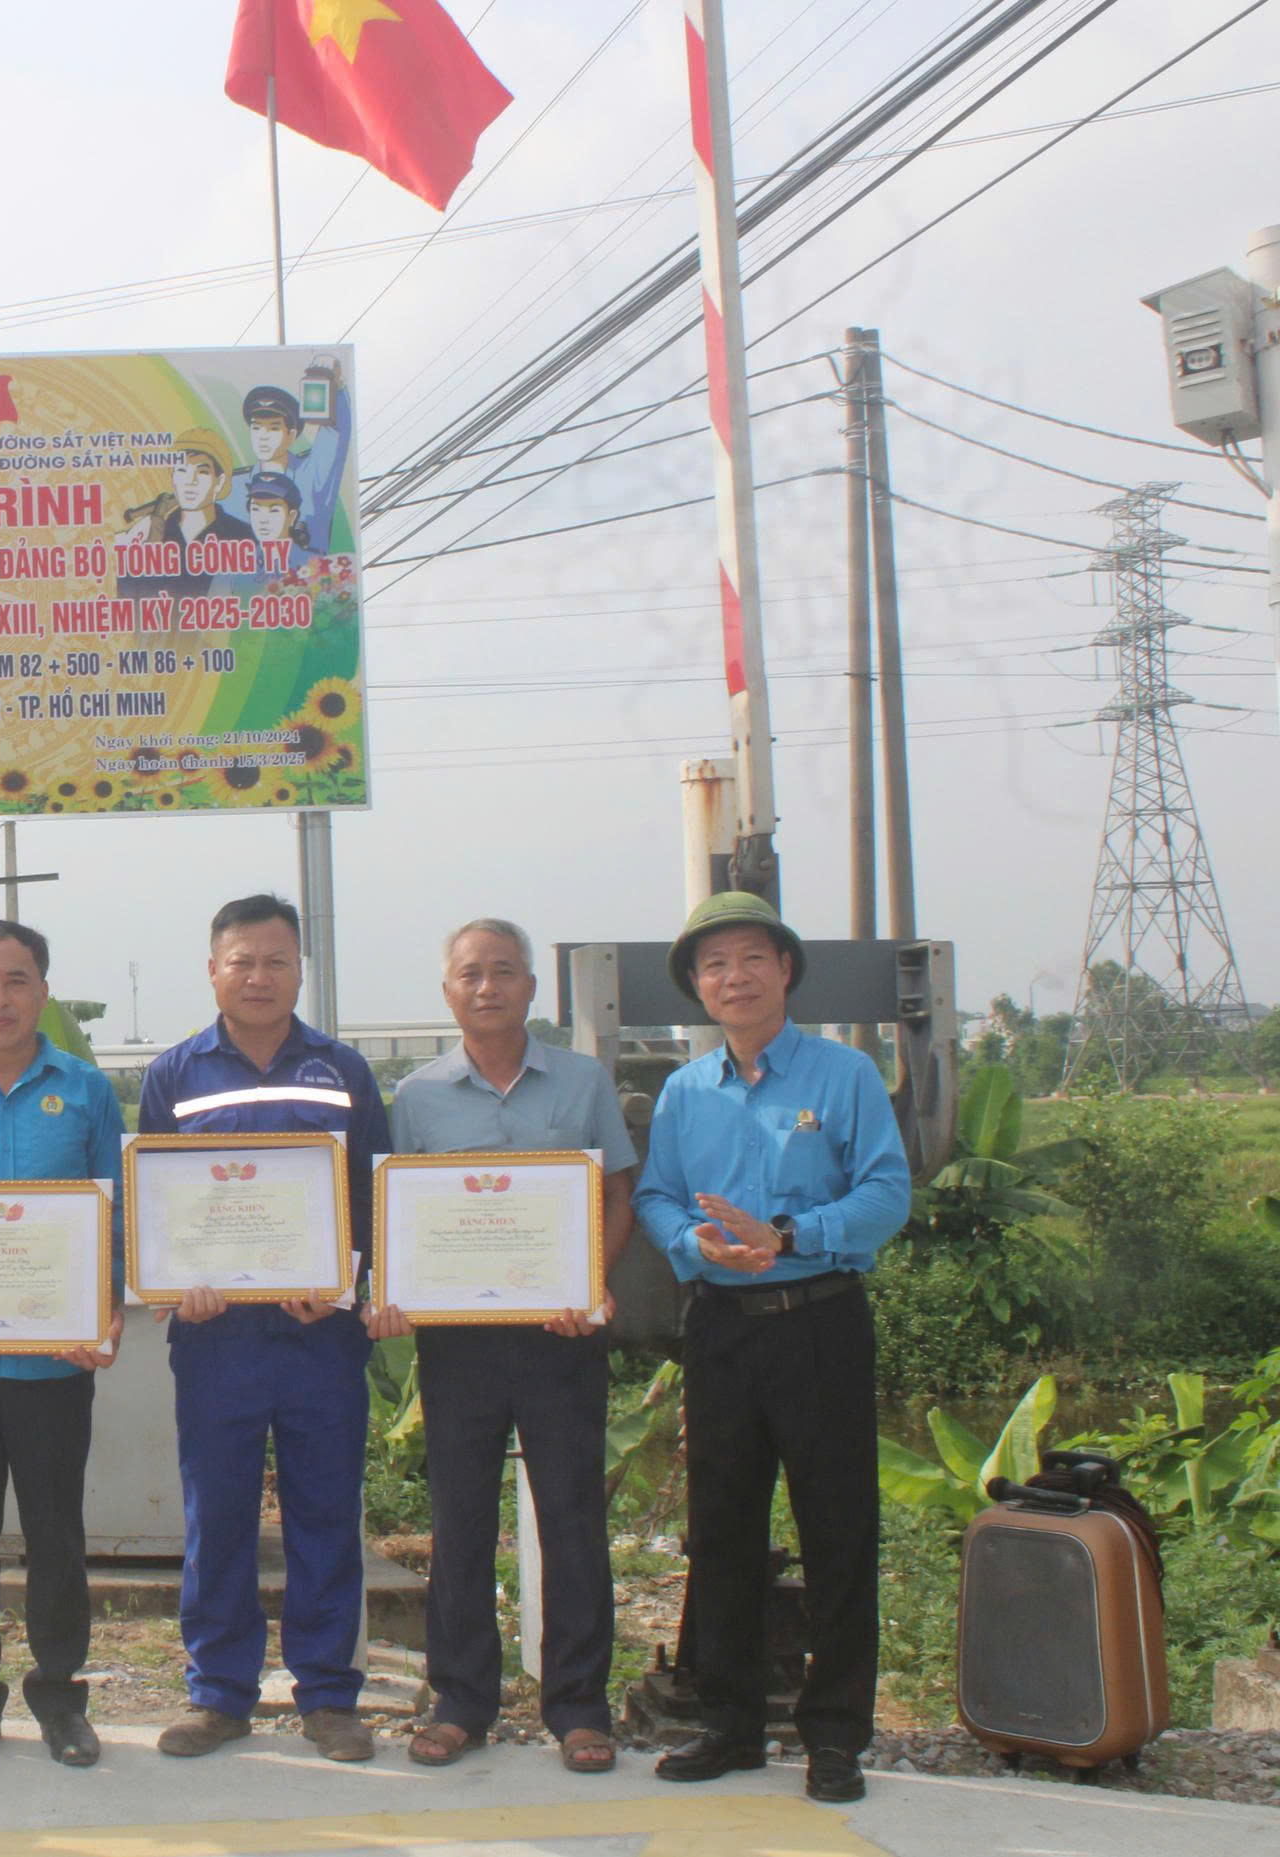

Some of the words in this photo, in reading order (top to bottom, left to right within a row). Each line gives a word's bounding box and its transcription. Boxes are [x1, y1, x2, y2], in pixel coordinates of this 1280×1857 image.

[52, 430, 84, 448] SẮT
[88, 431, 125, 450] VIỆT
[131, 433, 172, 446] NAM
[0, 454, 66, 471] ĐƯỜNG
[71, 449, 103, 468] SẮT
[109, 451, 135, 467] HÀ
[141, 452, 185, 466] NINH
[74, 539, 106, 584] BỘ
[114, 532, 180, 576] TỔNG
[186, 532, 255, 574] CÔNG
[263, 540, 291, 573] TY
[52, 594, 134, 639] NHIỆM
[141, 591, 172, 632] KỲ
[180, 595, 312, 630] 2025-2030
[20, 654, 42, 677] 82
[67, 652, 100, 676] 500
[119, 651, 148, 674] KM
[154, 650, 176, 674] 86
[201, 649, 234, 672] 100
[18, 695, 43, 719] TP.
[80, 689, 110, 717] CHÍ
[116, 692, 165, 716] MINH
[224, 730, 300, 744] 21/10/2024
